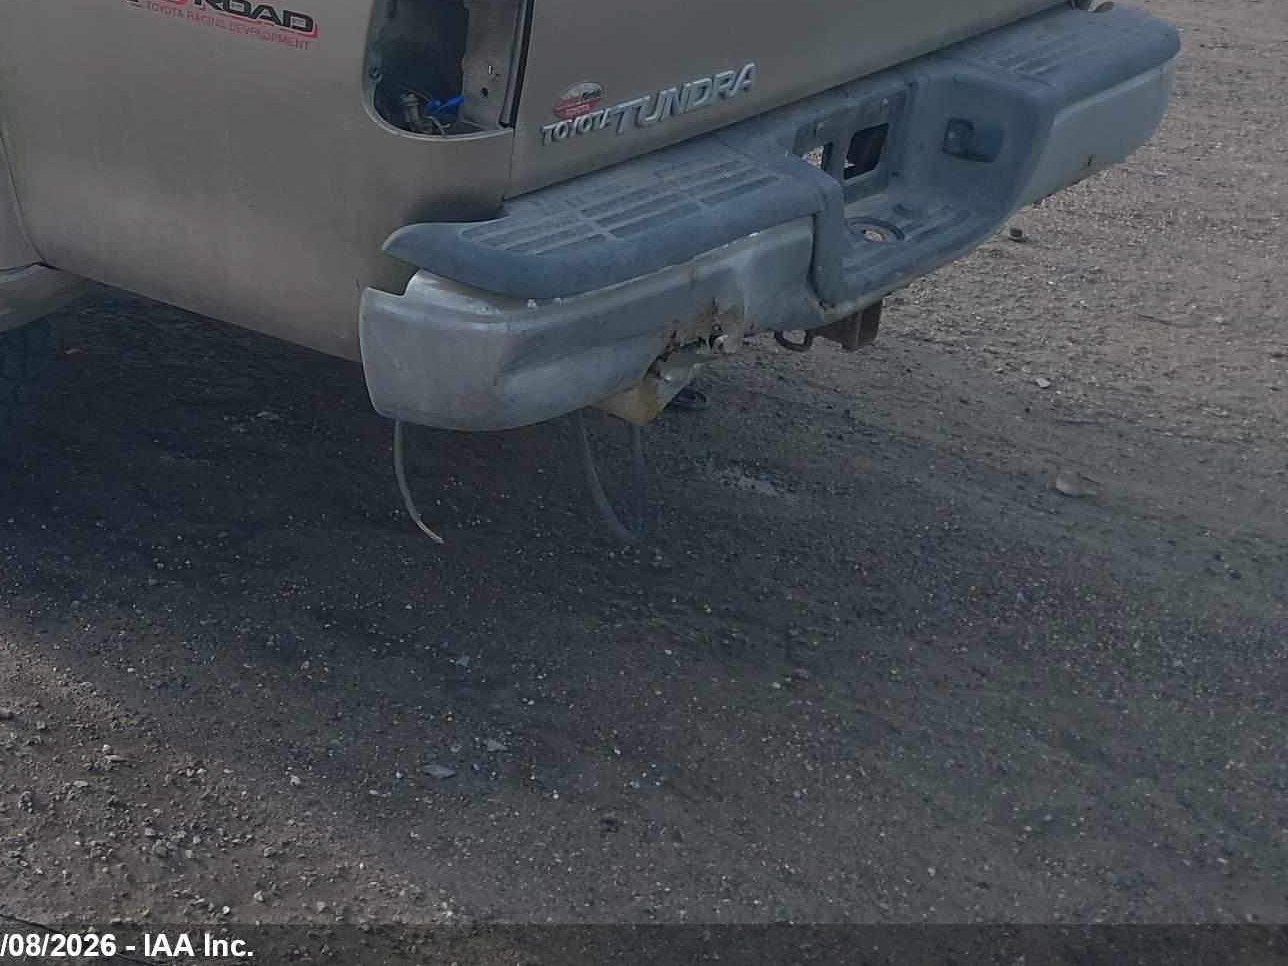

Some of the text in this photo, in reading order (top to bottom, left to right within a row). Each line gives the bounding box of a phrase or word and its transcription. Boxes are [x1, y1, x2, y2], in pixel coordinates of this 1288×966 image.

[146, 0, 311, 51] TOYOTA RACING DEVELOPMENT
[541, 62, 756, 146] TOYOTA TUNDRA
